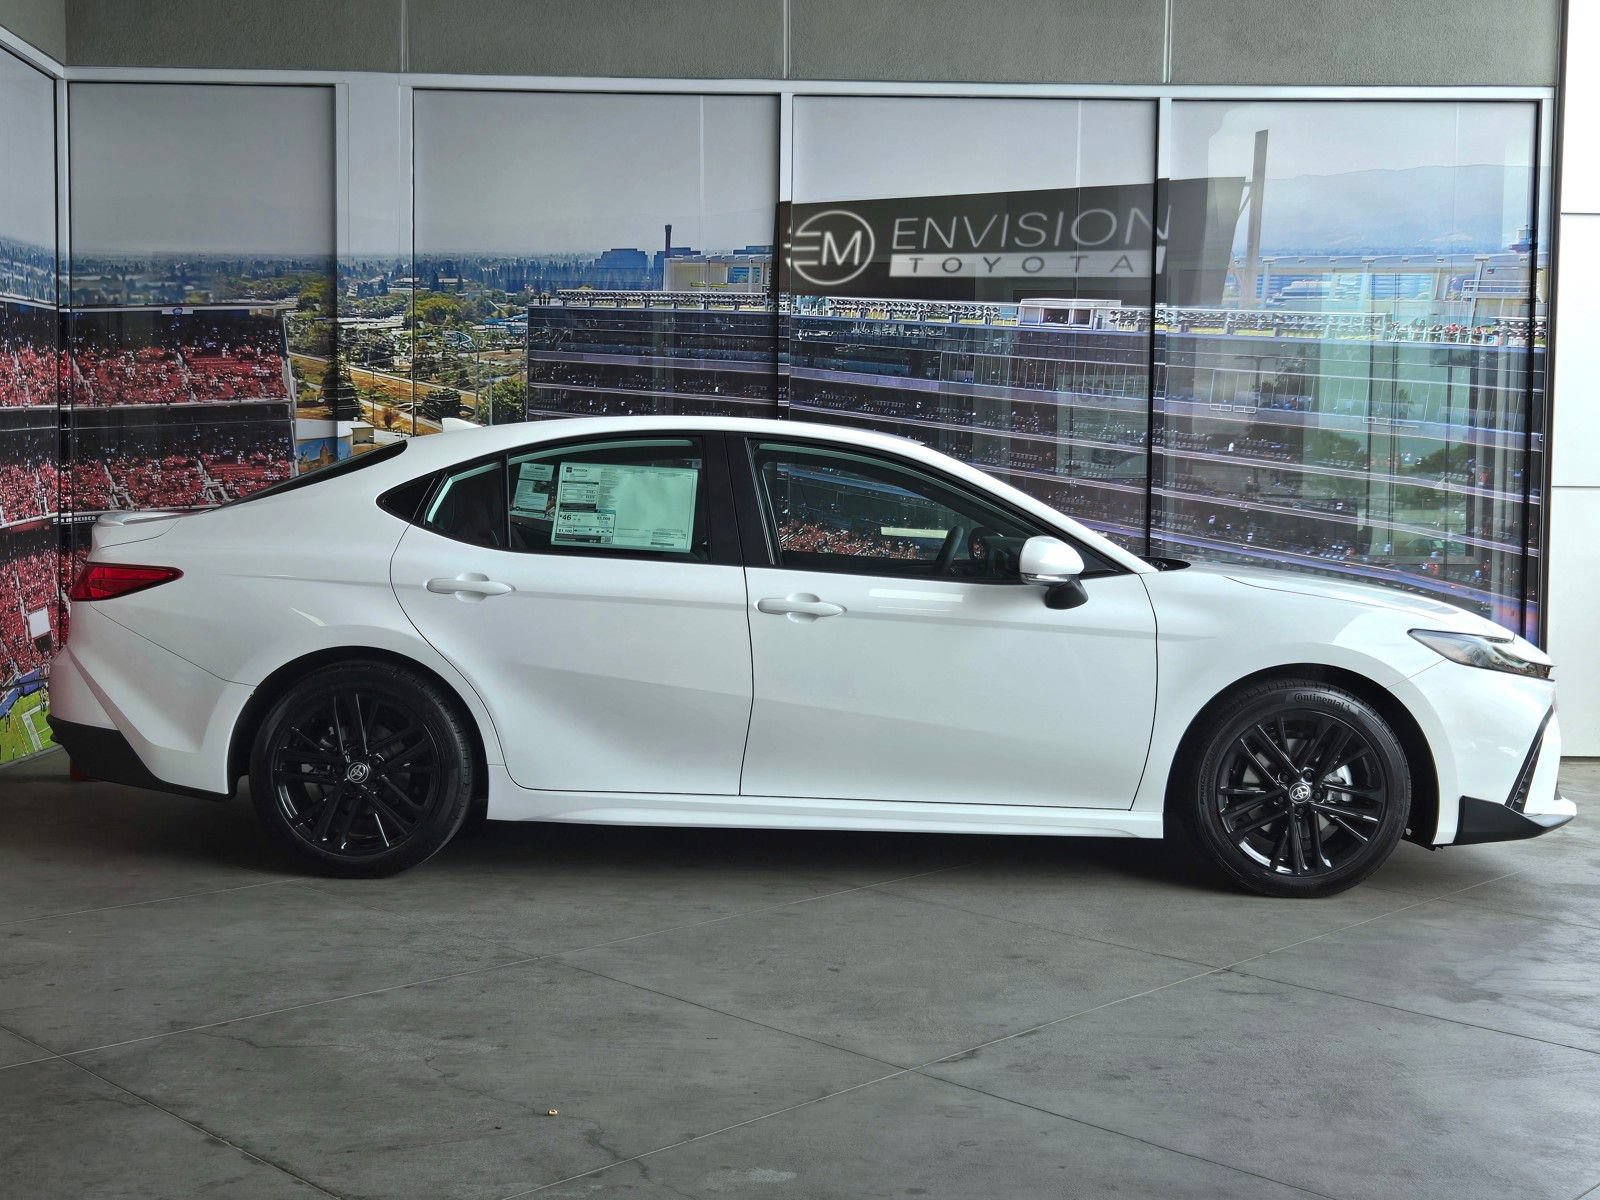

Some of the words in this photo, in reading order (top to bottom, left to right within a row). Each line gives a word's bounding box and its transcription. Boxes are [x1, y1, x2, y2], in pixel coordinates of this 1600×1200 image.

[892, 205, 1172, 250] ENVISION
[908, 254, 1135, 274] TOYOTA
[1294, 692, 1345, 708] Continental
